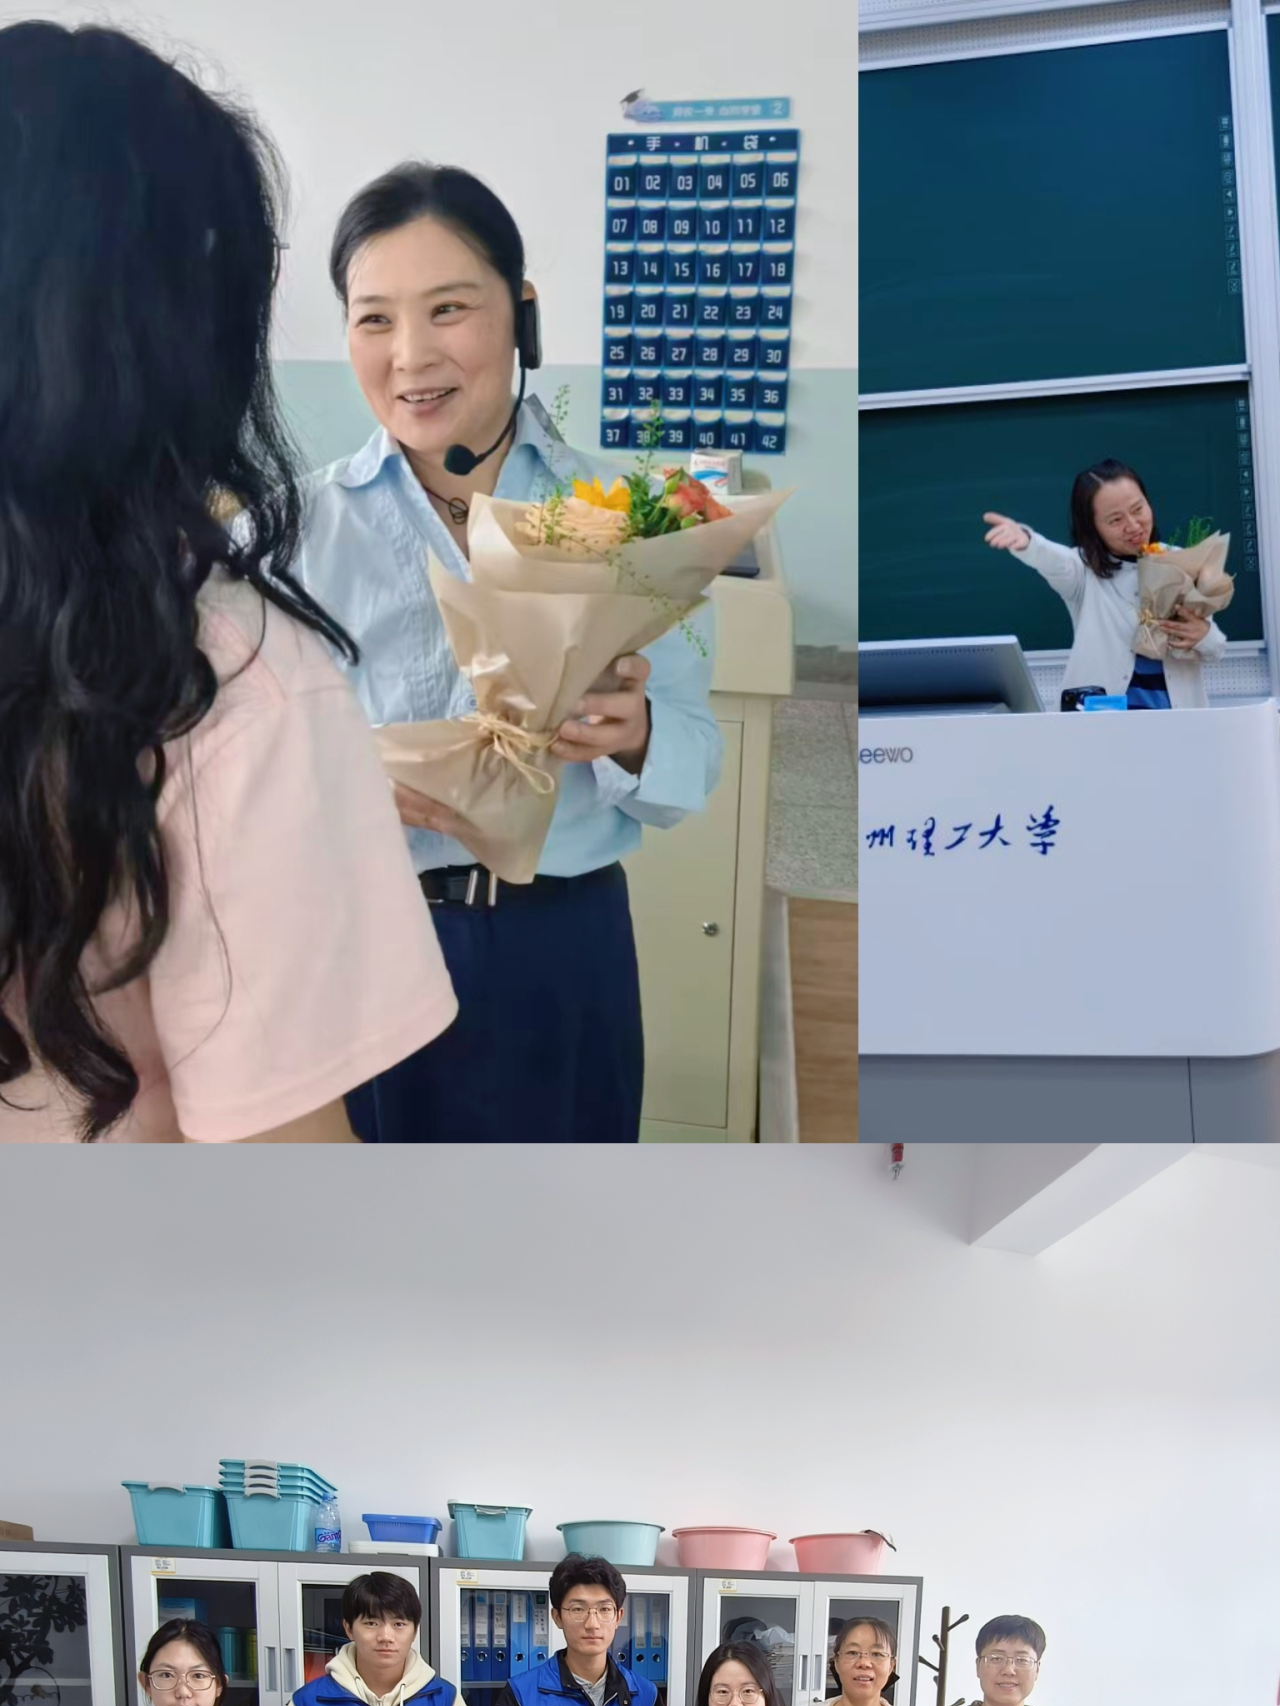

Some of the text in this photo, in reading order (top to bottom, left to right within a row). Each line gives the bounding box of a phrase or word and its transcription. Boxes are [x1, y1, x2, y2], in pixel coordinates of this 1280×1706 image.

[614, 172, 788, 191] 01 02 03 04 05 06
[612, 219, 785, 235] 07 08 09 10 11 12
[613, 261, 785, 277] 13 14 15 16 17 18
[610, 304, 782, 320] 19 20 21 22 23 24
[610, 346, 782, 363] 25 26 27 28 29 30
[609, 387, 778, 403] 31 32 33 34 35 36
[606, 429, 620, 442] 37
[669, 430, 683, 443] 39
[699, 432, 714, 445] 40
[731, 433, 745, 445] 41
[762, 435, 777, 448] 42
[866, 804, 1061, 856] 州理工大学
